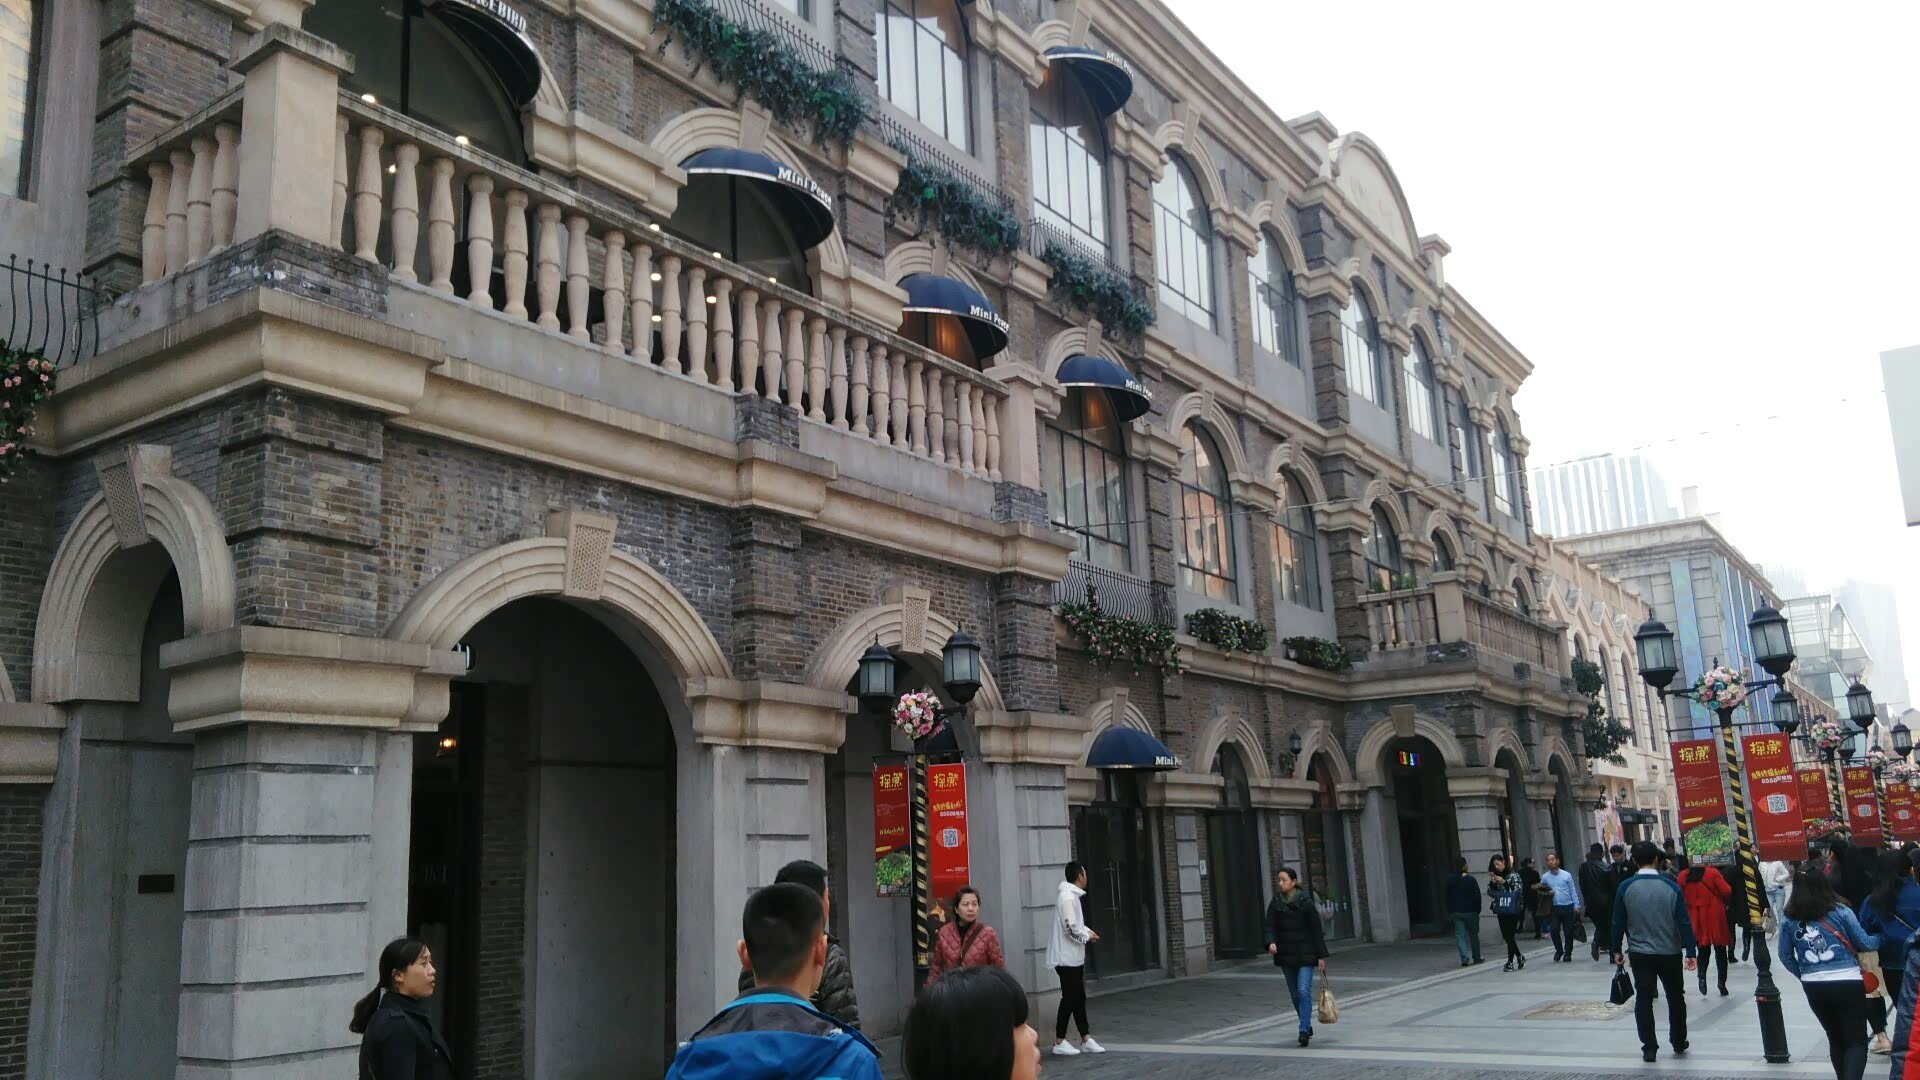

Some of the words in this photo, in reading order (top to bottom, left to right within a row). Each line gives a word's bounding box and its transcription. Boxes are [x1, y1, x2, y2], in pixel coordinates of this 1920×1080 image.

[777, 166, 809, 189] Mini
[970, 304, 992, 321] Mini
[1155, 755, 1174, 766] Mini
